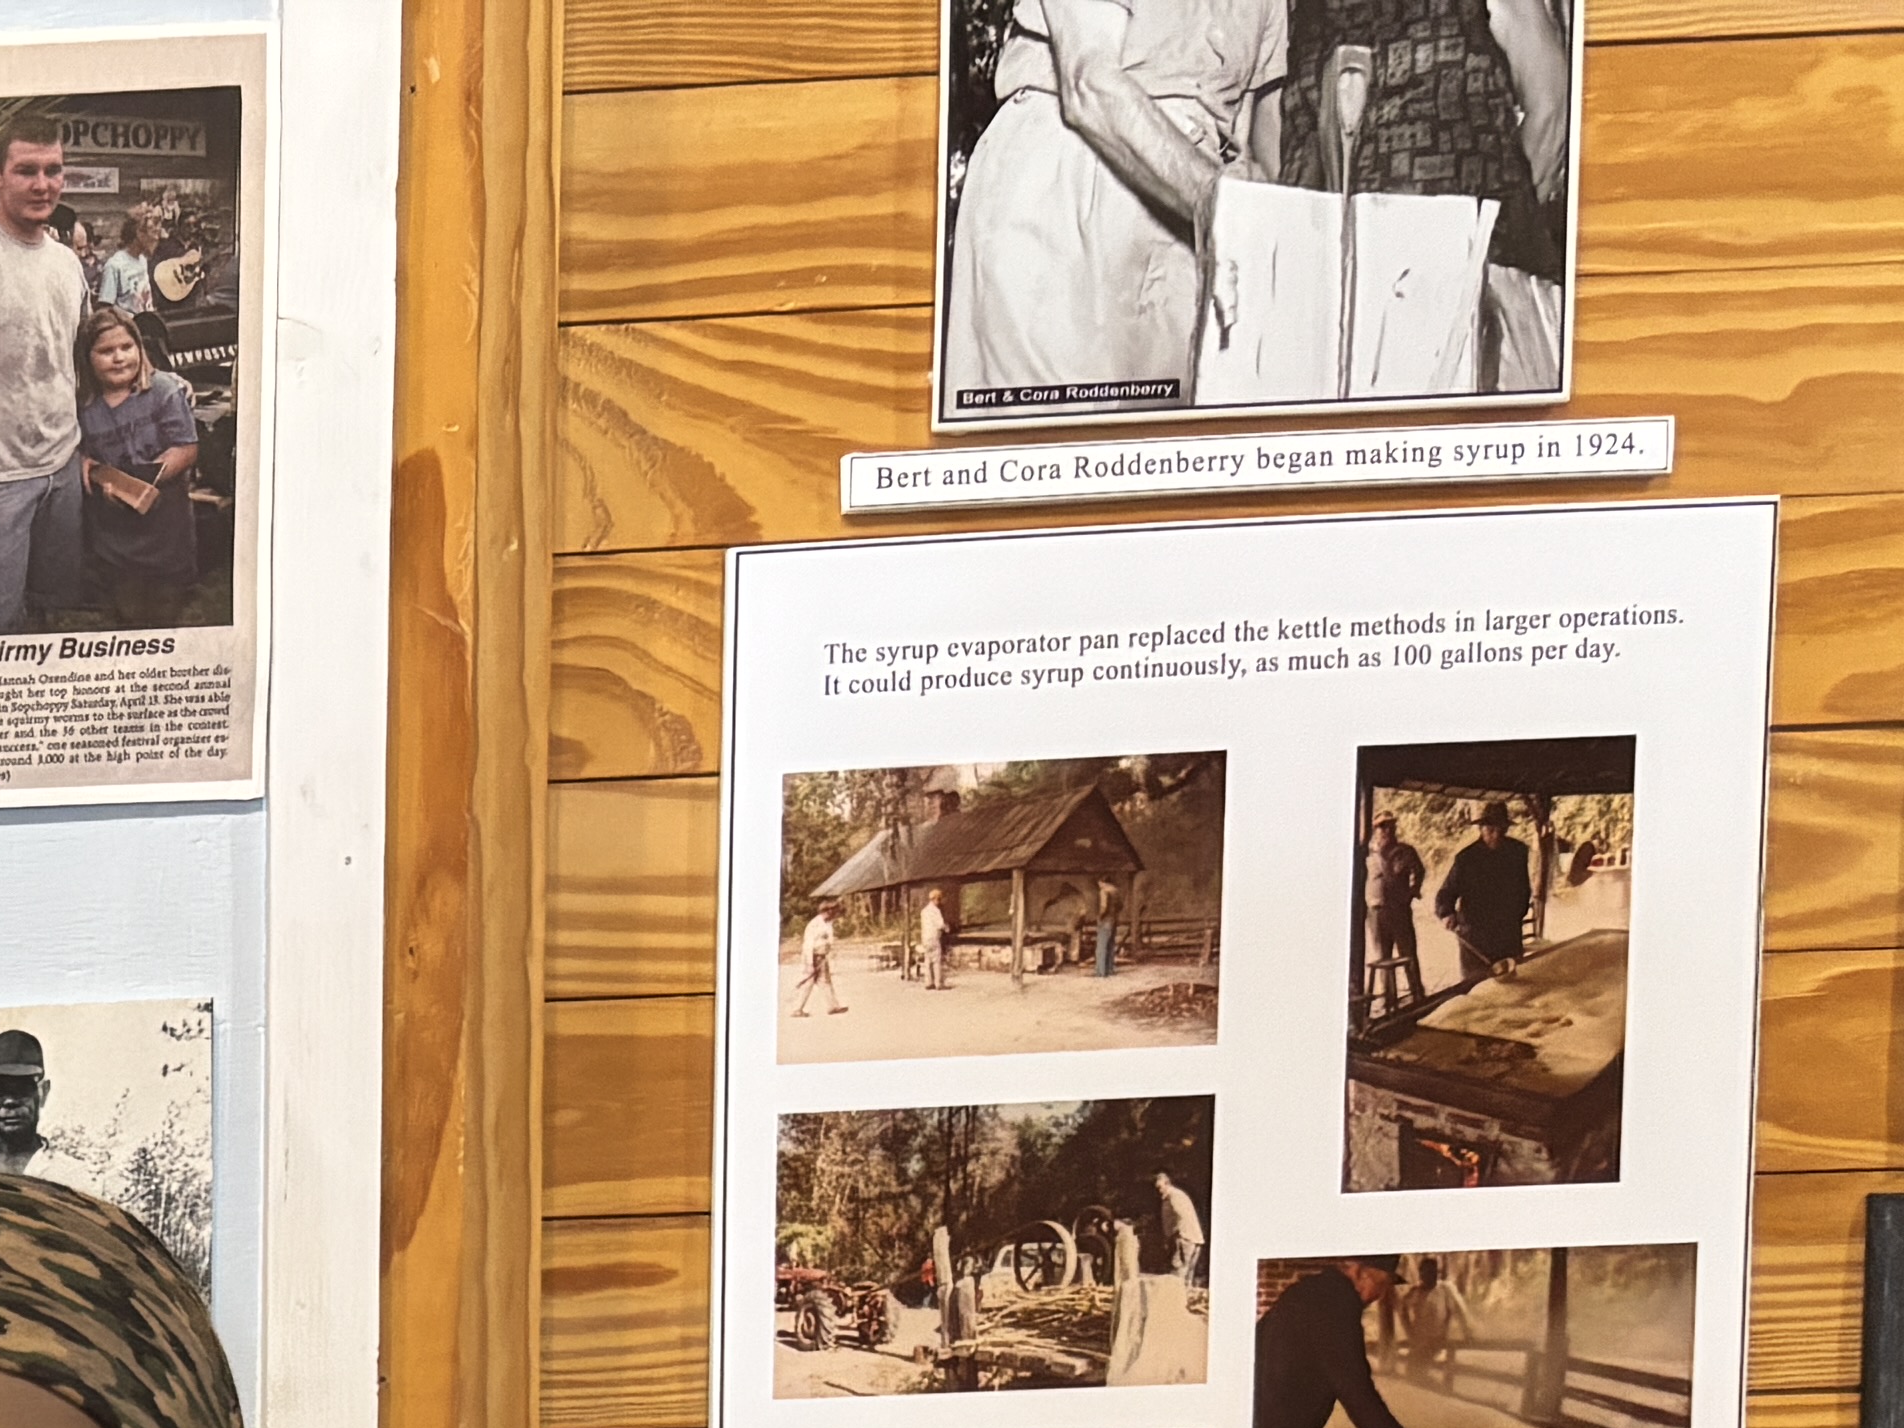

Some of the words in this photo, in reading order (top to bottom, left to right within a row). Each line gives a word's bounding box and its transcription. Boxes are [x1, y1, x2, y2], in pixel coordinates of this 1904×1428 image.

[963, 391, 997, 405] Bert
[1002, 390, 1014, 403] &
[1019, 389, 1060, 402] Cora
[1065, 383, 1173, 402] Roddenberry
[876, 466, 931, 490] Bert
[942, 460, 988, 486] and
[1000, 460, 1061, 483] Cora
[1074, 450, 1244, 479] Roddenberry
[1257, 446, 1333, 474] began
[1346, 441, 1442, 468] making
[1453, 442, 1525, 467] syrup
[1538, 436, 1561, 458] in
[1576, 432, 1644, 457] 1924.
[58, 637, 175, 660] Business
[823, 642, 867, 665] The
[875, 643, 939, 667] syrup
[947, 634, 1072, 662] evaporator
[1079, 633, 1119, 657] pan
[1129, 625, 1225, 653] replaced
[1234, 624, 1269, 643] the
[1277, 621, 1341, 641] kettle
[1350, 617, 1446, 637] methods
[1455, 617, 1475, 633] in
[1485, 613, 1552, 636] larger
[1559, 609, 1684, 634] operations.
